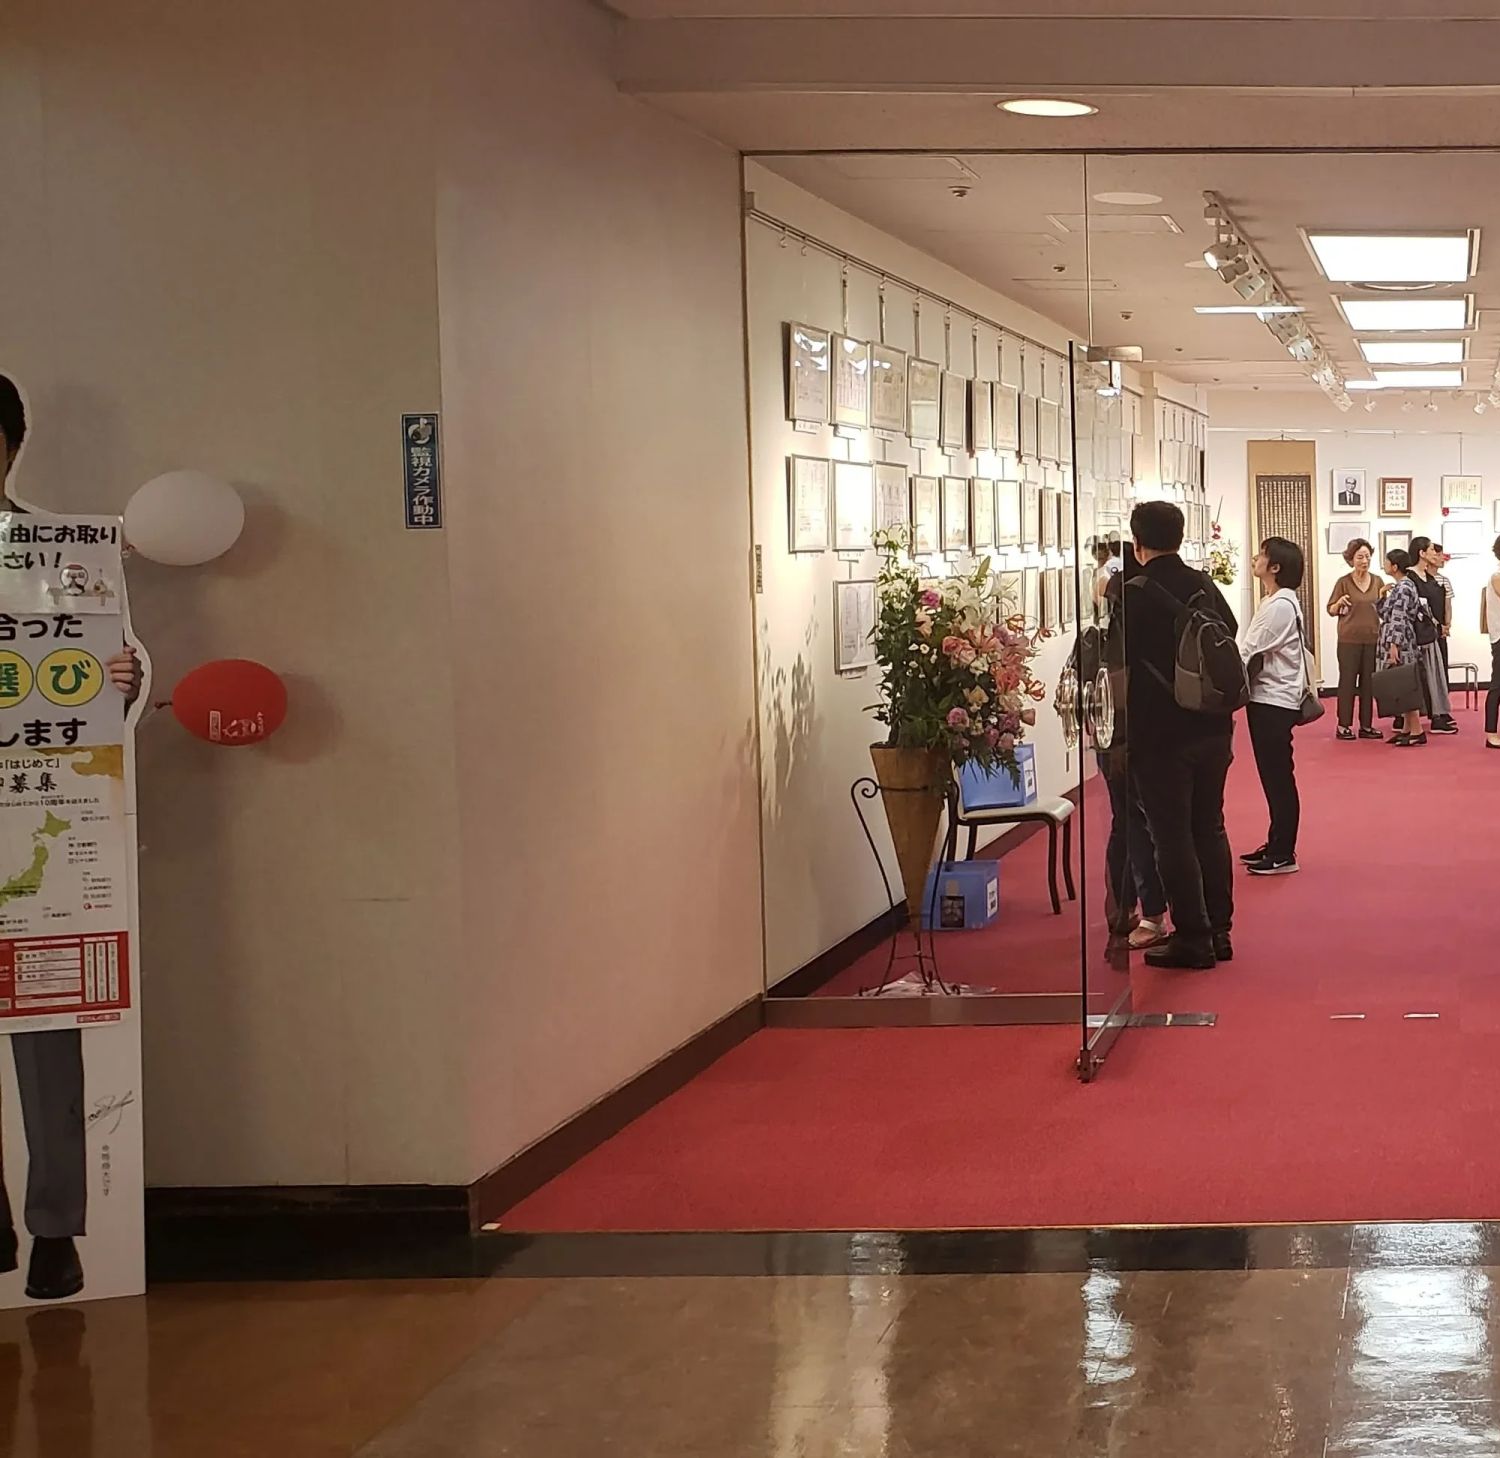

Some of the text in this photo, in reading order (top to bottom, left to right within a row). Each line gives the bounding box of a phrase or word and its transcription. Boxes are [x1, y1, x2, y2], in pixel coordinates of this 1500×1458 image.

[410, 446, 434, 525] 監視カメラ作動中
[0, 523, 117, 544] 由にお取り
[0, 551, 62, 570] さい！
[0, 757, 60, 770] 「はじめて」
